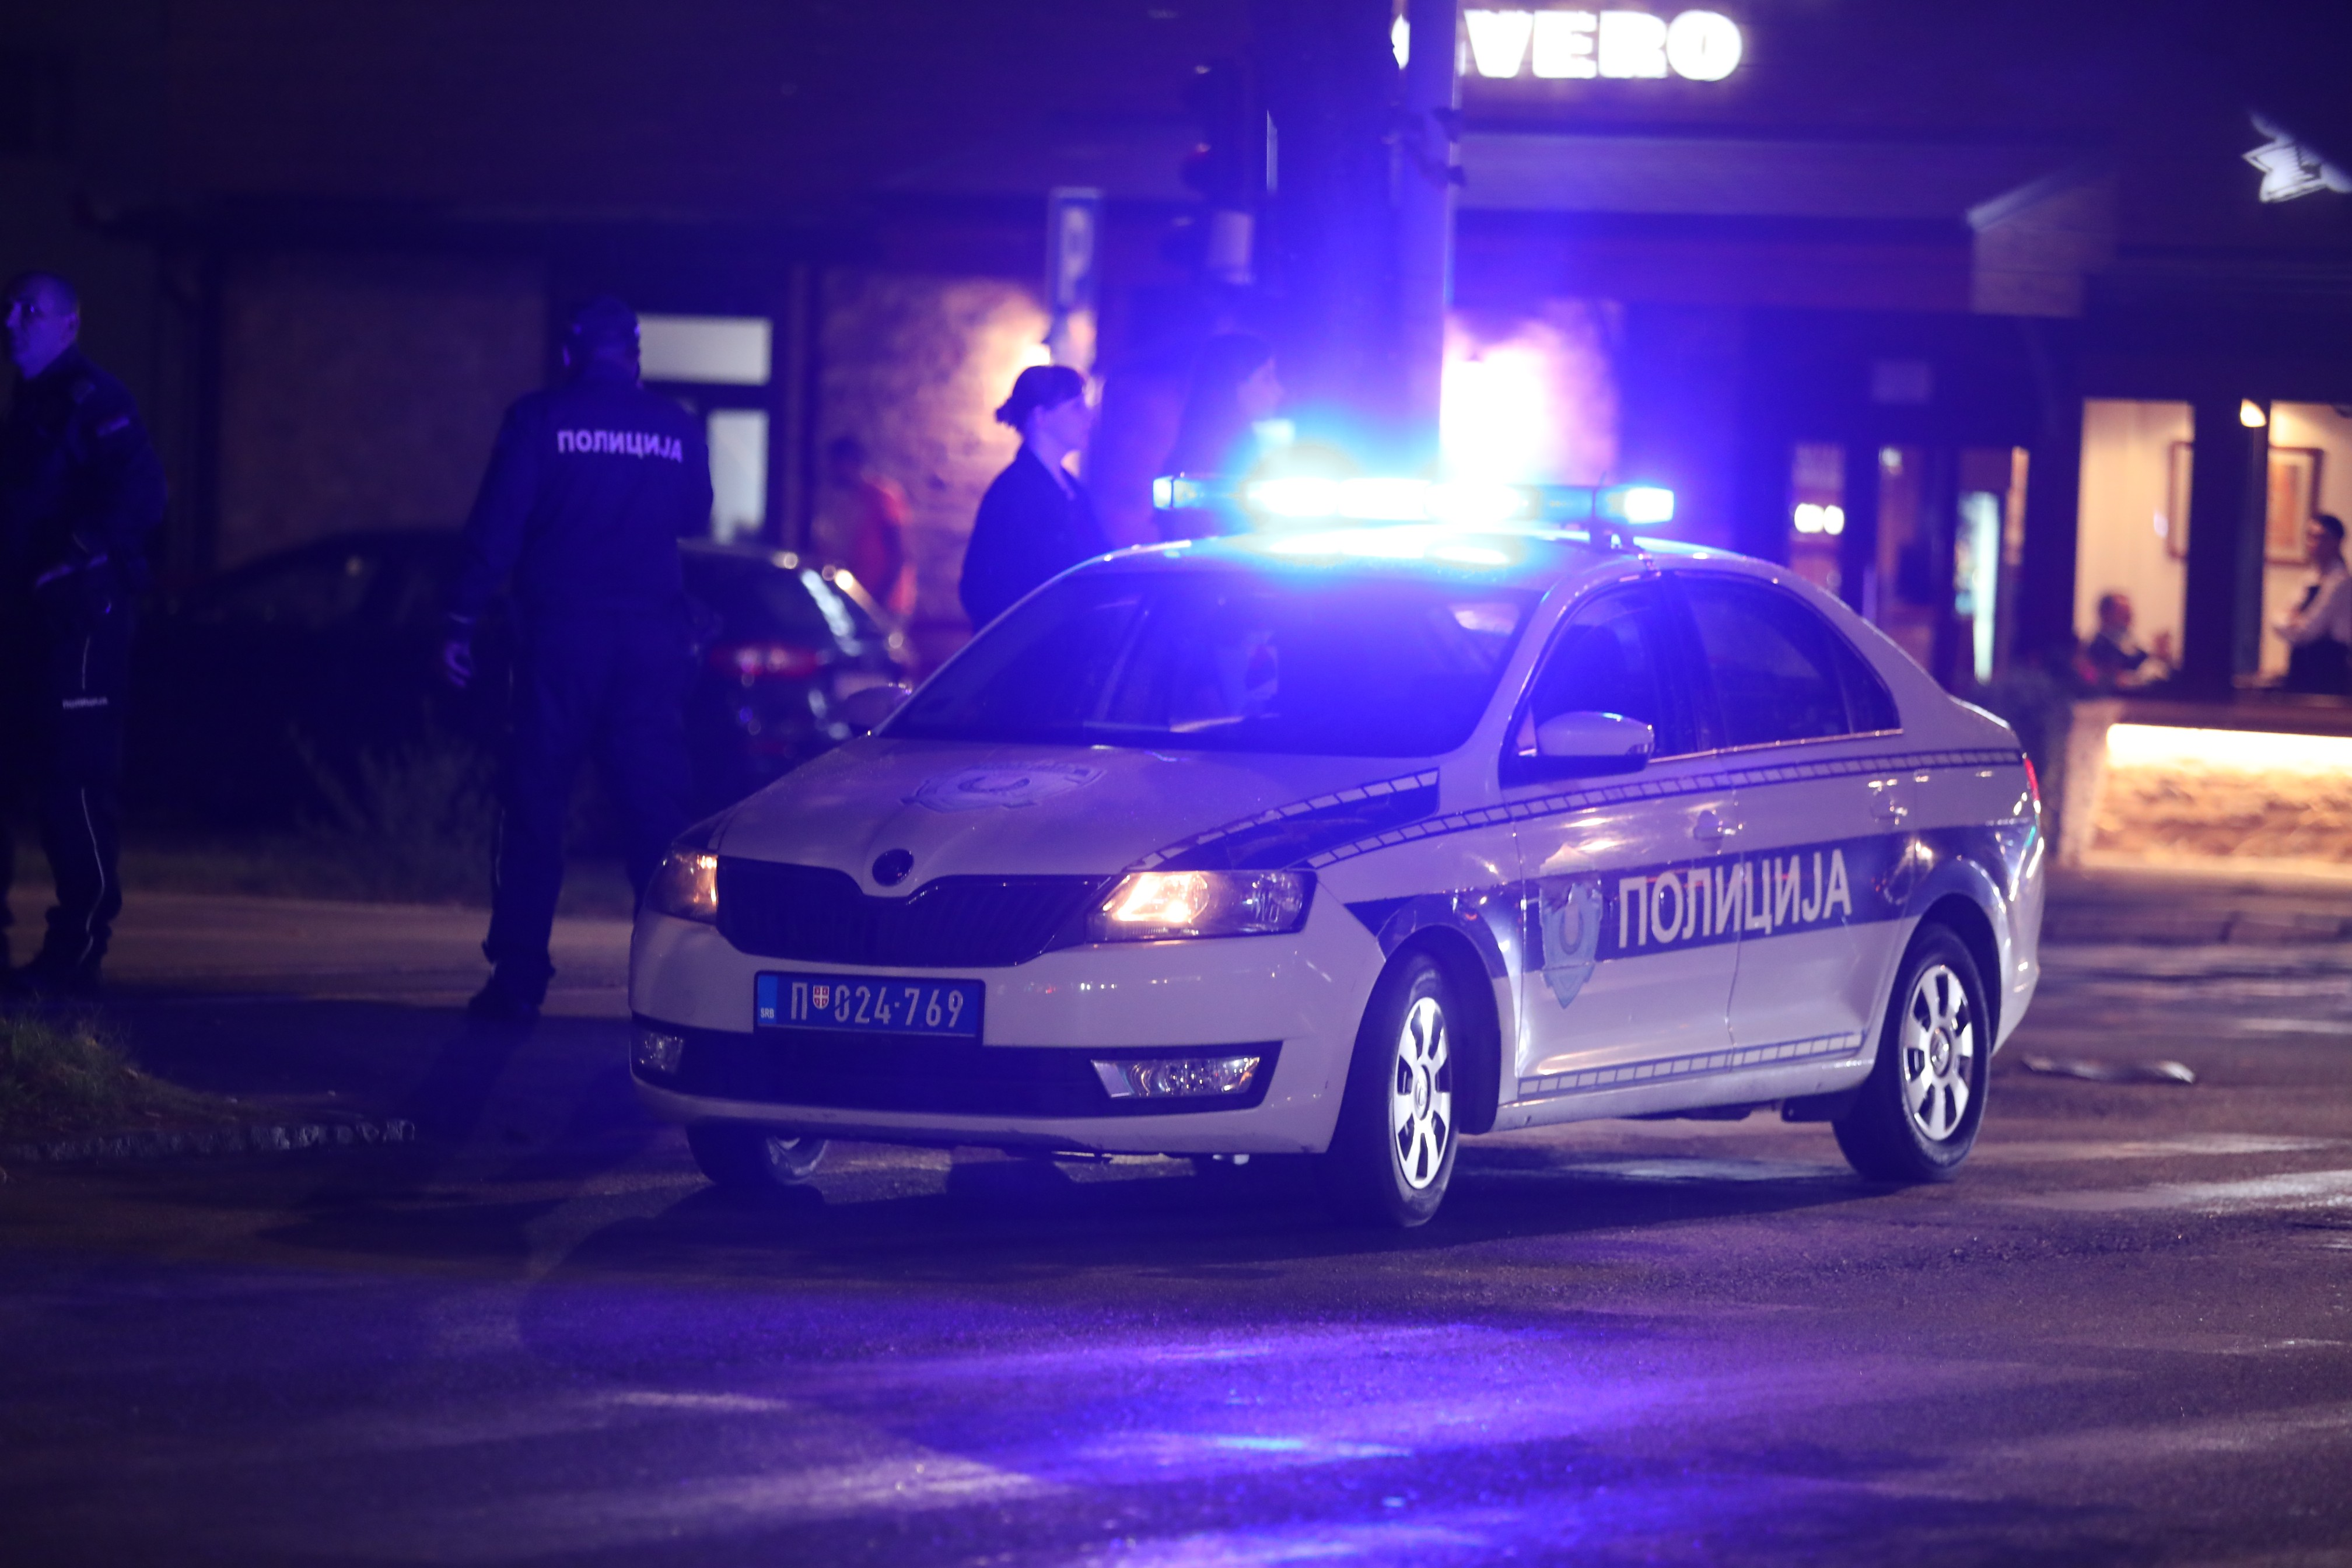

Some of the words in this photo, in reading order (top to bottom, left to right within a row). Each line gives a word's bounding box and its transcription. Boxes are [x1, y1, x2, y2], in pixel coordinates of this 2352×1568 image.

[1464, 10, 1742, 81] VERO
[557, 428, 682, 463] ПОЛИЦИЈА
[1618, 848, 1852, 949] ПОЛИЦИЈА
[760, 1007, 775, 1019] SRB
[790, 982, 808, 1021] П
